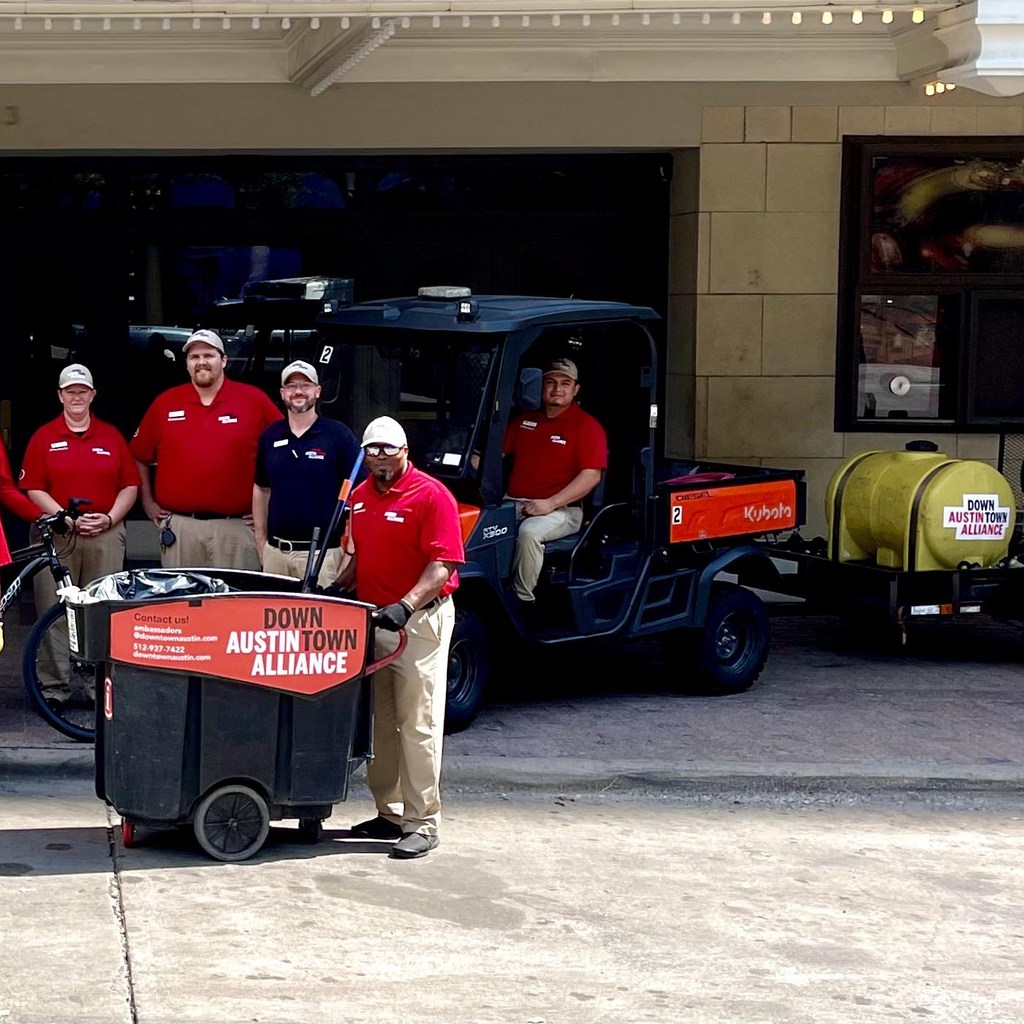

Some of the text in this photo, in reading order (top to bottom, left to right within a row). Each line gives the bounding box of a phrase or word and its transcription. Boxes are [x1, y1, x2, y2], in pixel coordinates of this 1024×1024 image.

[322, 347, 331, 362] 2
[676, 491, 713, 502] DIESEL
[967, 499, 995, 511] DOWN
[673, 507, 681, 523] 2
[744, 502, 791, 523] Kubota
[948, 511, 1008, 523] AUSTIN TOWN
[961, 524, 1004, 536] ALLIANCE
[133, 613, 189, 624] Contact us!
[264, 607, 323, 629] DOWN
[133, 625, 182, 634] ambassadors
[133, 632, 218, 642] @downtownaustin.com
[226, 629, 357, 654] AUSTIN TOWN
[133, 643, 185, 653] 512-937-7422
[132, 650, 211, 661] downtownaustin.com
[251, 652, 348, 676] ALLIANCE
